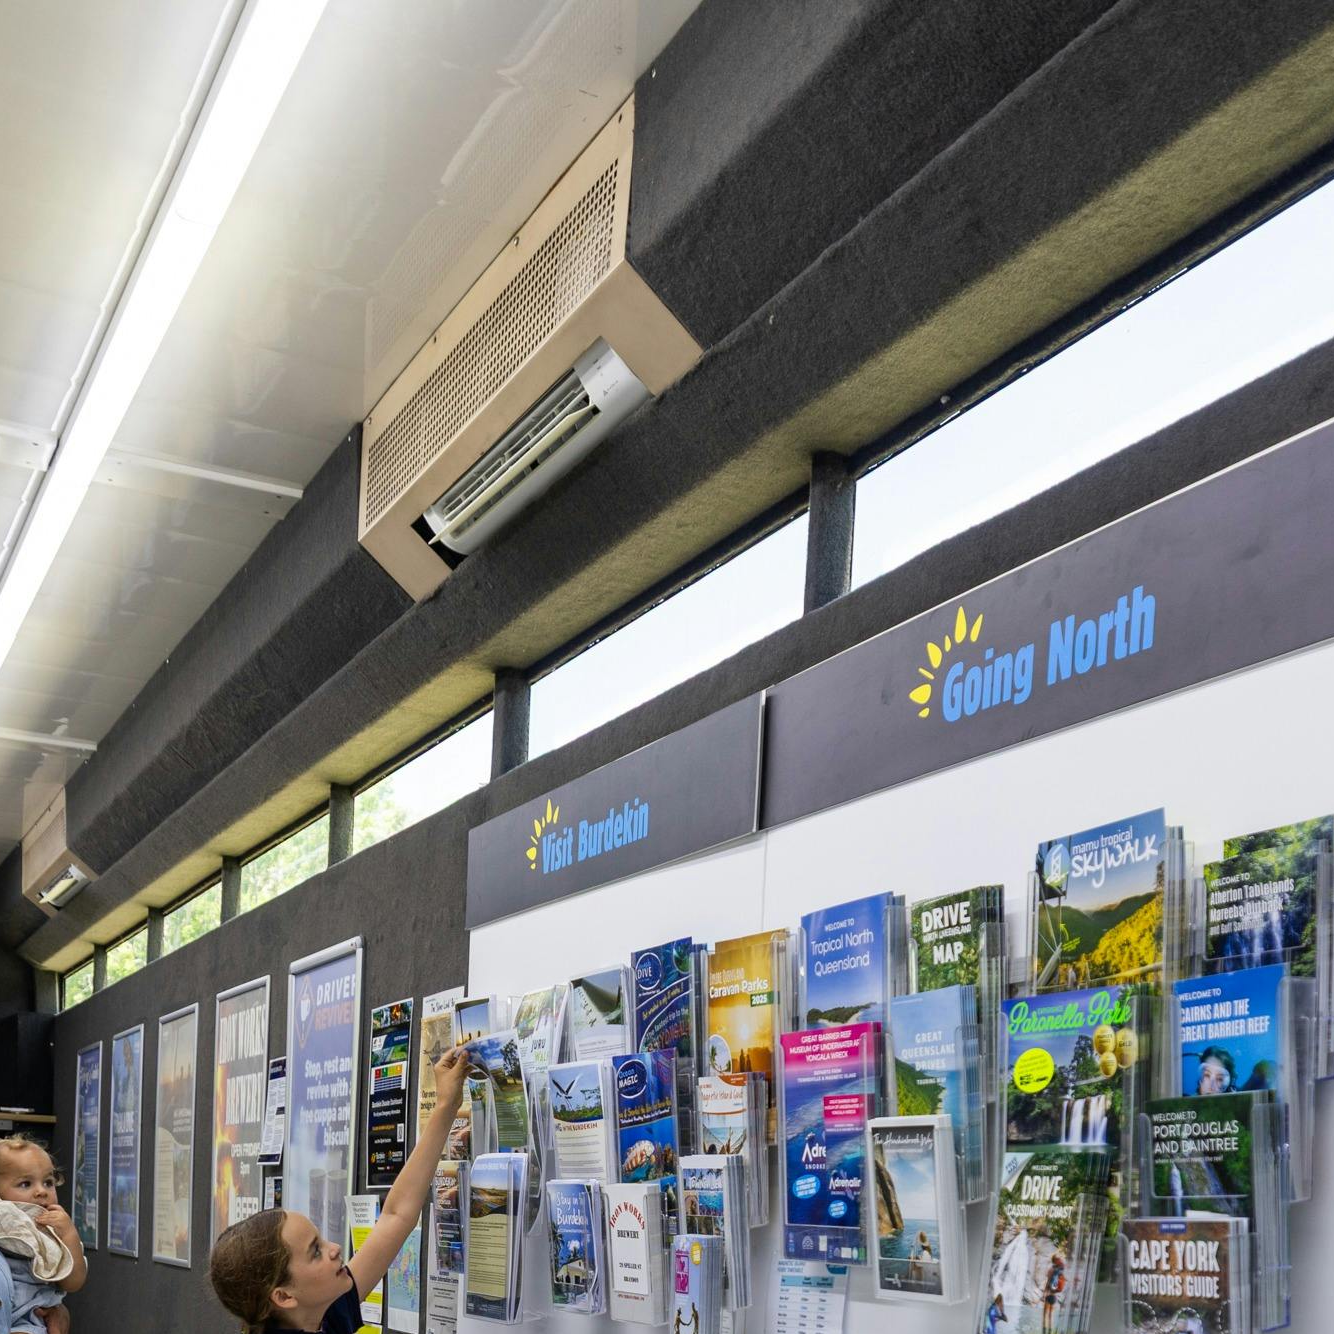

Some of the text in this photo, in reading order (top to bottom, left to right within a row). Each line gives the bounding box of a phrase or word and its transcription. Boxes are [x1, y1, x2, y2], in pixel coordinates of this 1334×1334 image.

[942, 585, 1156, 722] Going North
[542, 798, 649, 875] Visit Burdekin
[1072, 825, 1133, 855] mamu tropical
[1211, 872, 1251, 887] WELCOME TO
[1211, 878, 1295, 905] Atherton Tablelands
[824, 918, 854, 932] WELCOME TO
[922, 901, 971, 933] DRIVE
[811, 929, 874, 957] Tropical North
[933, 941, 964, 965] MAP
[637, 968, 652, 979] DIVE
[814, 952, 871, 977] Queensland
[710, 982, 740, 999] Caravan
[741, 977, 768, 992] Parks
[751, 994, 767, 1004] 2025
[1179, 988, 1222, 1001] WELCOME TO
[1007, 990, 1133, 1035] Paronella Park
[1180, 998, 1251, 1023] CAIRNS AND THE
[219, 1003, 266, 1065] IRON WORKS
[801, 1030, 852, 1044] GREAT BARRIER REEF
[915, 1031, 942, 1044] GREAT
[1180, 1016, 1270, 1042] GREAT BARRIER REEF
[789, 1040, 853, 1054] MUSEUM OF UNDERWATER
[806, 1051, 848, 1062] YONGALA WRECK
[916, 1058, 947, 1071] DRIVES
[307, 1078, 348, 1101] revive with
[619, 1074, 638, 1088] MAGIC
[225, 1071, 263, 1126] BREWERY
[1153, 1110, 1197, 1122] WELCOME TO
[1153, 1119, 1240, 1139] PORT DOUGLAS
[1154, 1137, 1239, 1154] AND DAINTREE
[1021, 1175, 1063, 1201] DRIVE
[609, 1201, 645, 1230] IRON WORKS
[1007, 1203, 1073, 1219] CASSOWARY COAST
[617, 1230, 639, 1239] BREWERY
[1130, 1239, 1221, 1273] CAPE YORK
[1130, 1272, 1221, 1299] VISITORS GUIDE
